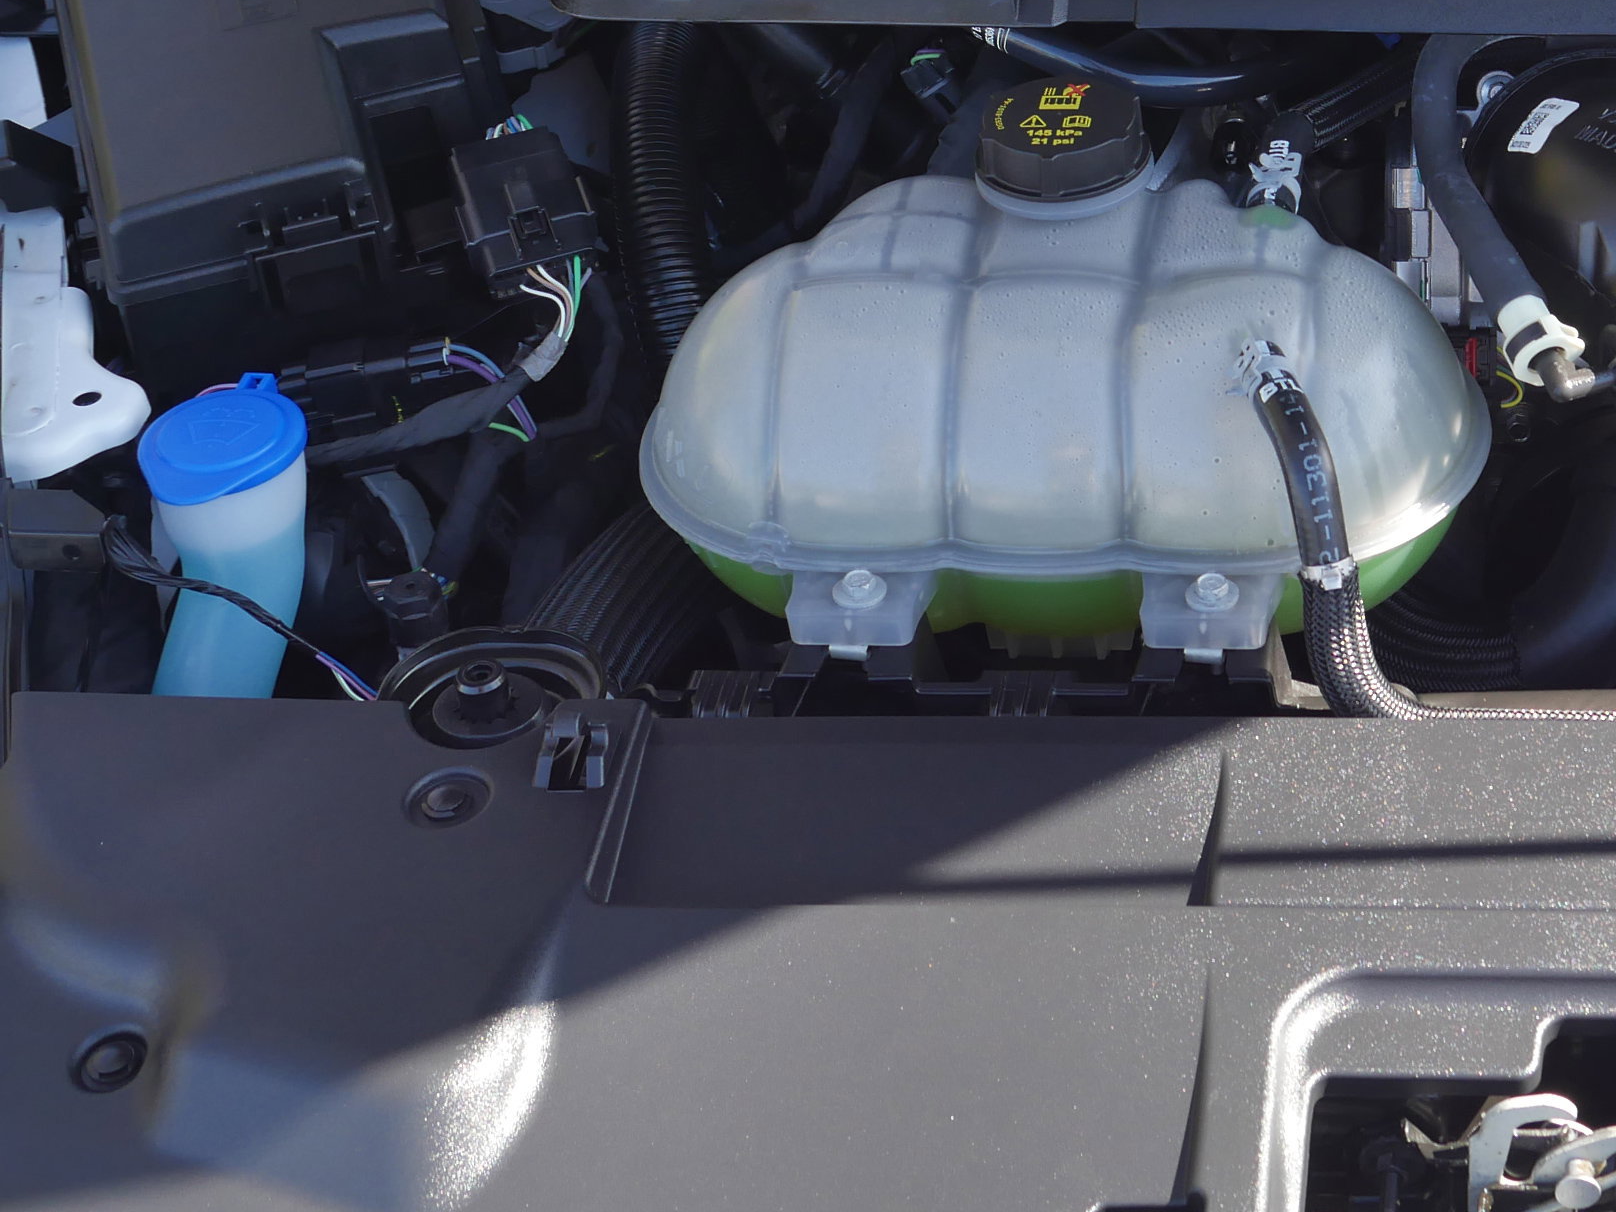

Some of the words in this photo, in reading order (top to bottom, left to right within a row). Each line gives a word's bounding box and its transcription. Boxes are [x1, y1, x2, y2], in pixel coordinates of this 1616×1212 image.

[1026, 129, 1053, 137] 145
[1055, 129, 1083, 137] kPa
[1052, 138, 1075, 146] psi
